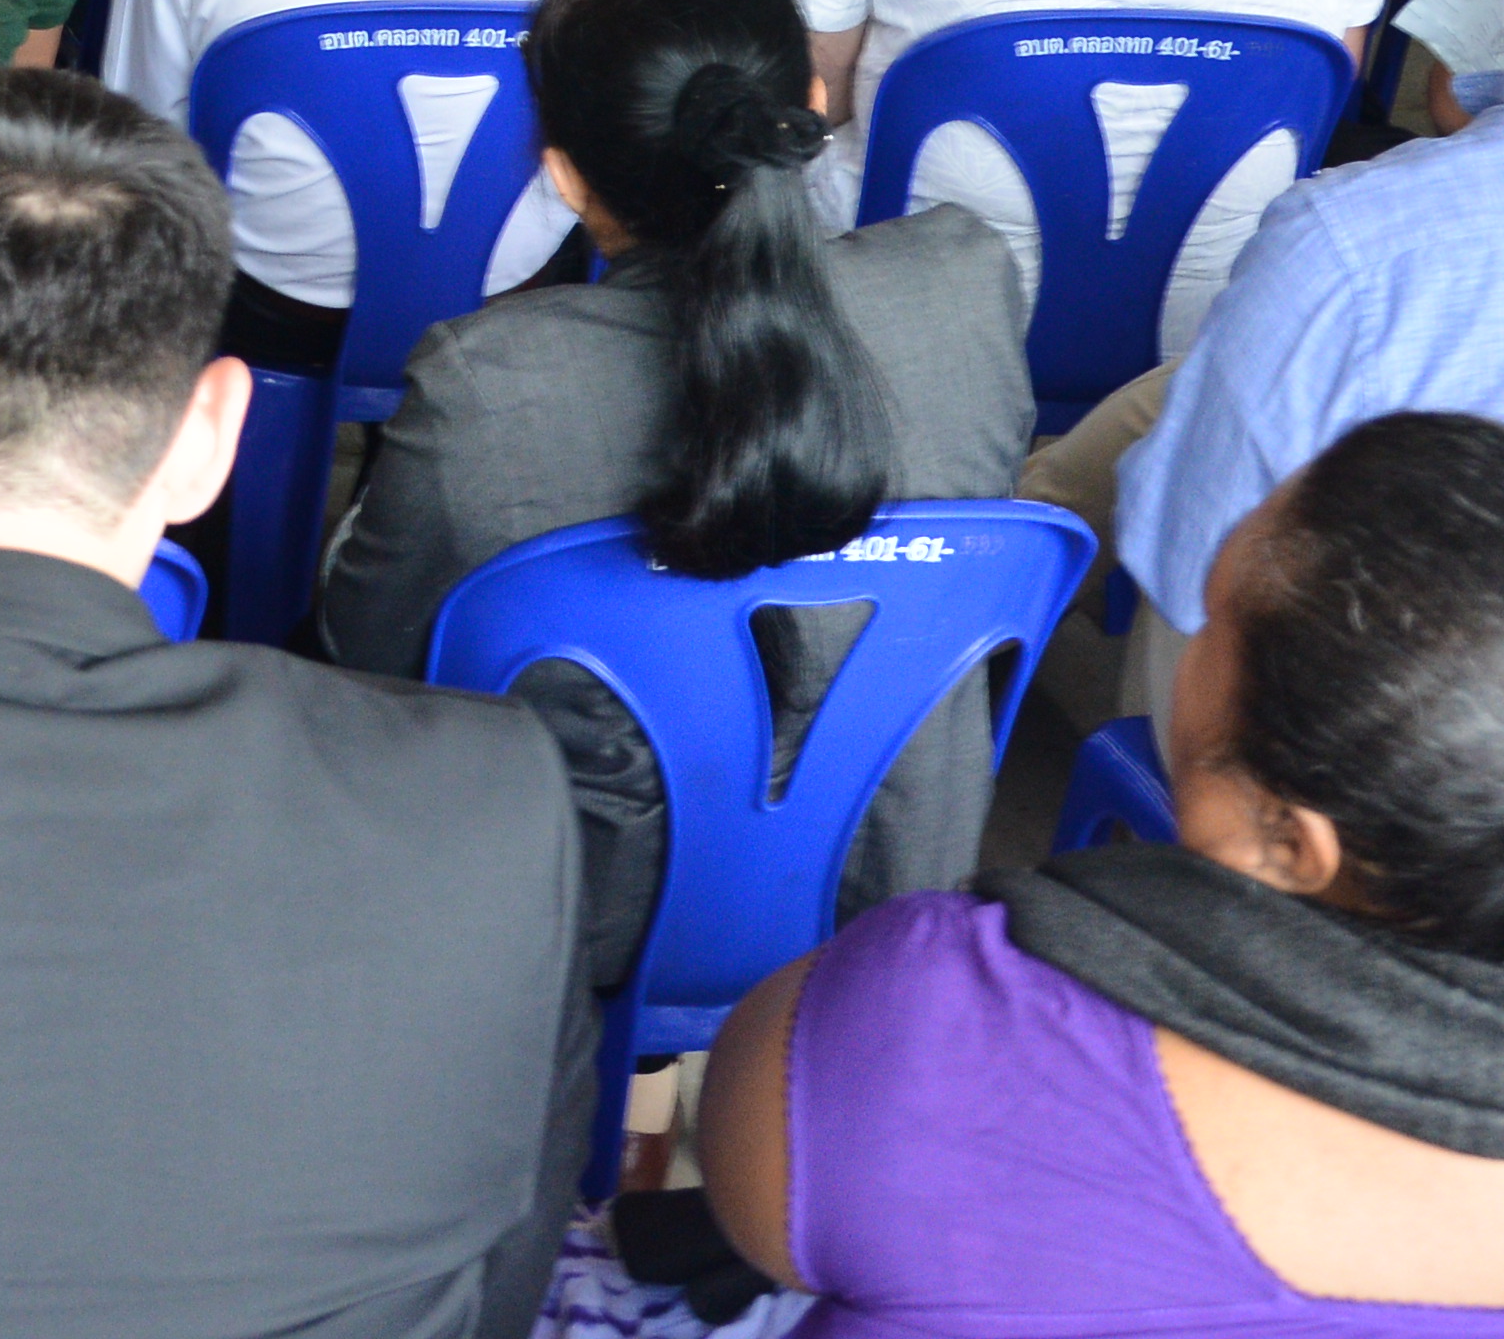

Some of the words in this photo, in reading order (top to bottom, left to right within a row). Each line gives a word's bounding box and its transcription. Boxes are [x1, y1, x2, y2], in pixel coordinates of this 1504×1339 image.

[318, 29, 461, 51] อบต.คลองหก
[1014, 36, 1153, 58] อบต.คลองหก
[1154, 37, 1241, 61] 401-61-
[841, 536, 955, 563] 401-61-
